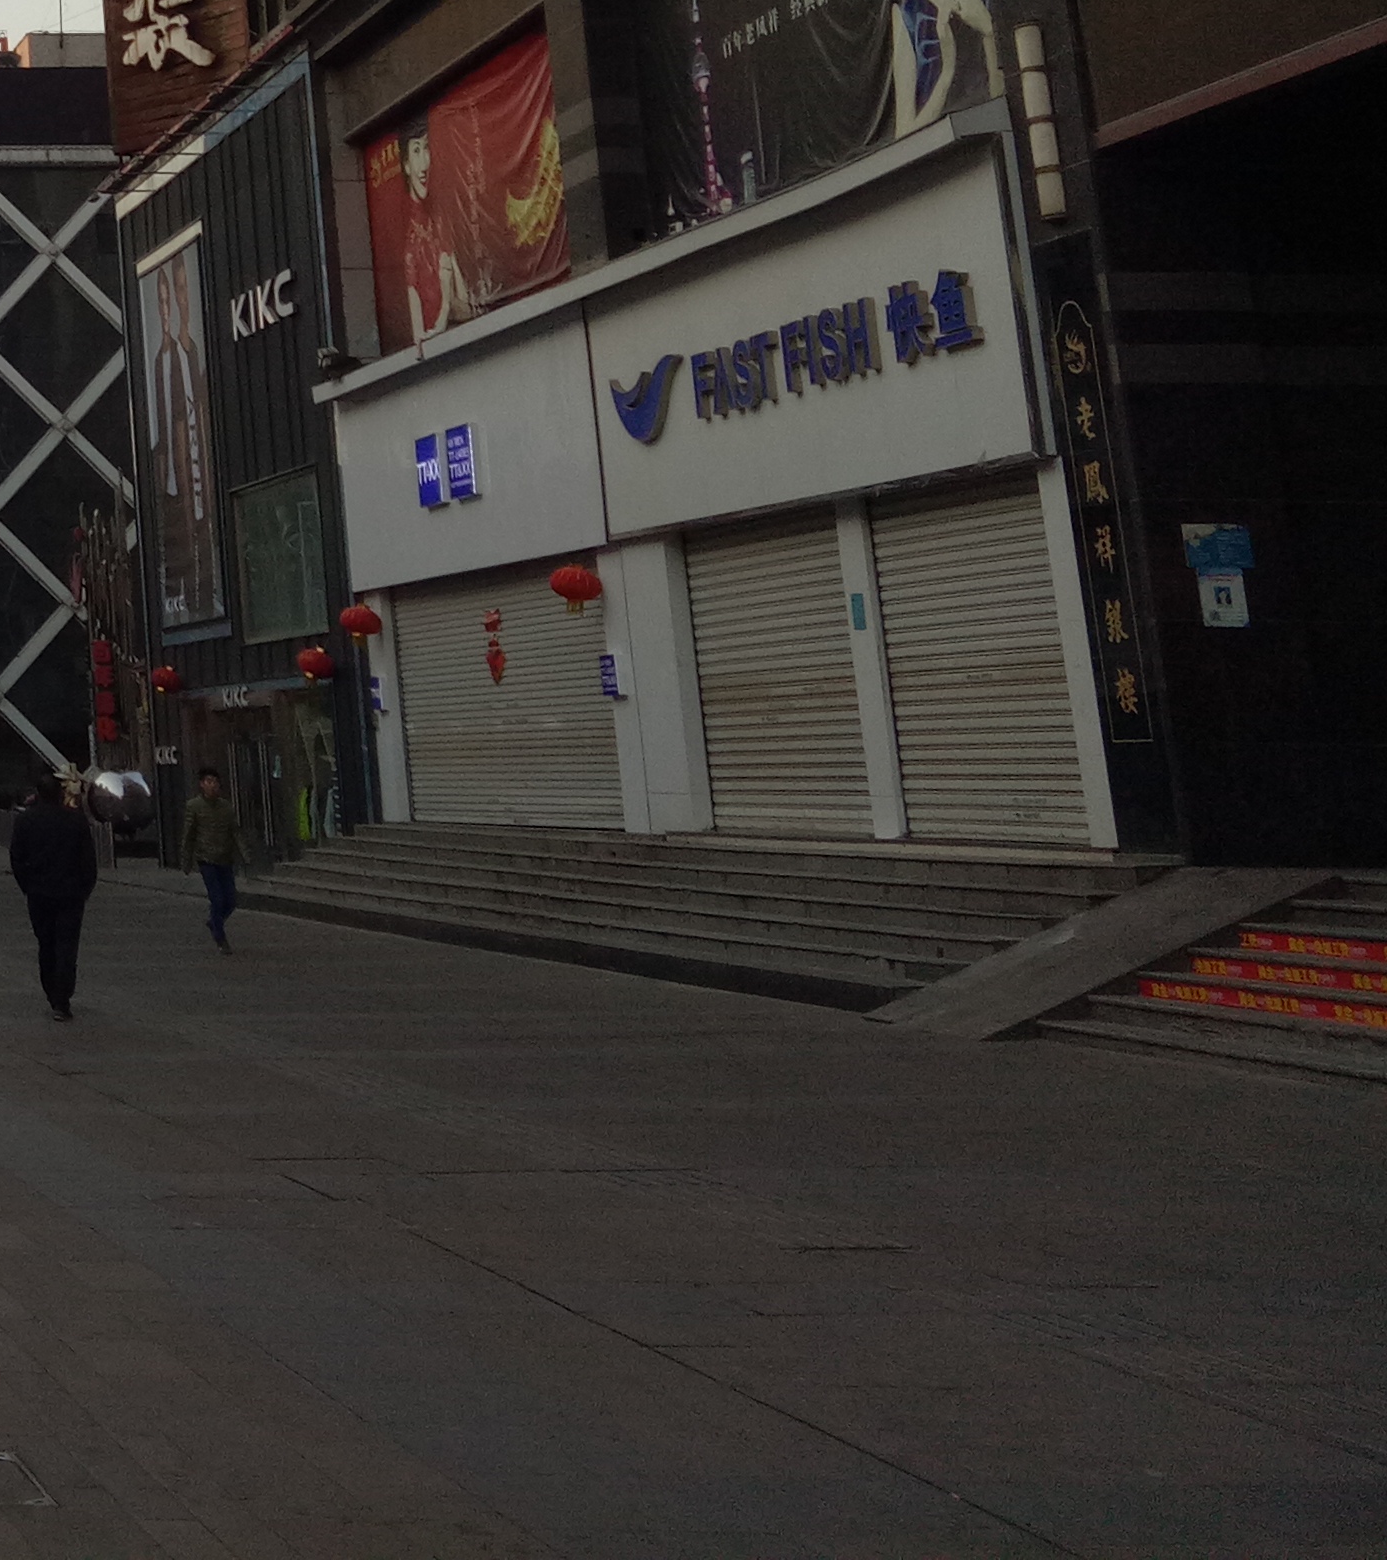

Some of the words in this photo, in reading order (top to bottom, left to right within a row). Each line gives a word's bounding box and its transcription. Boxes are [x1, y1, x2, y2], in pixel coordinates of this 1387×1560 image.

[691, 330, 778, 420] FAST
[780, 296, 881, 397] FISH
[885, 270, 984, 365] 快鱼
